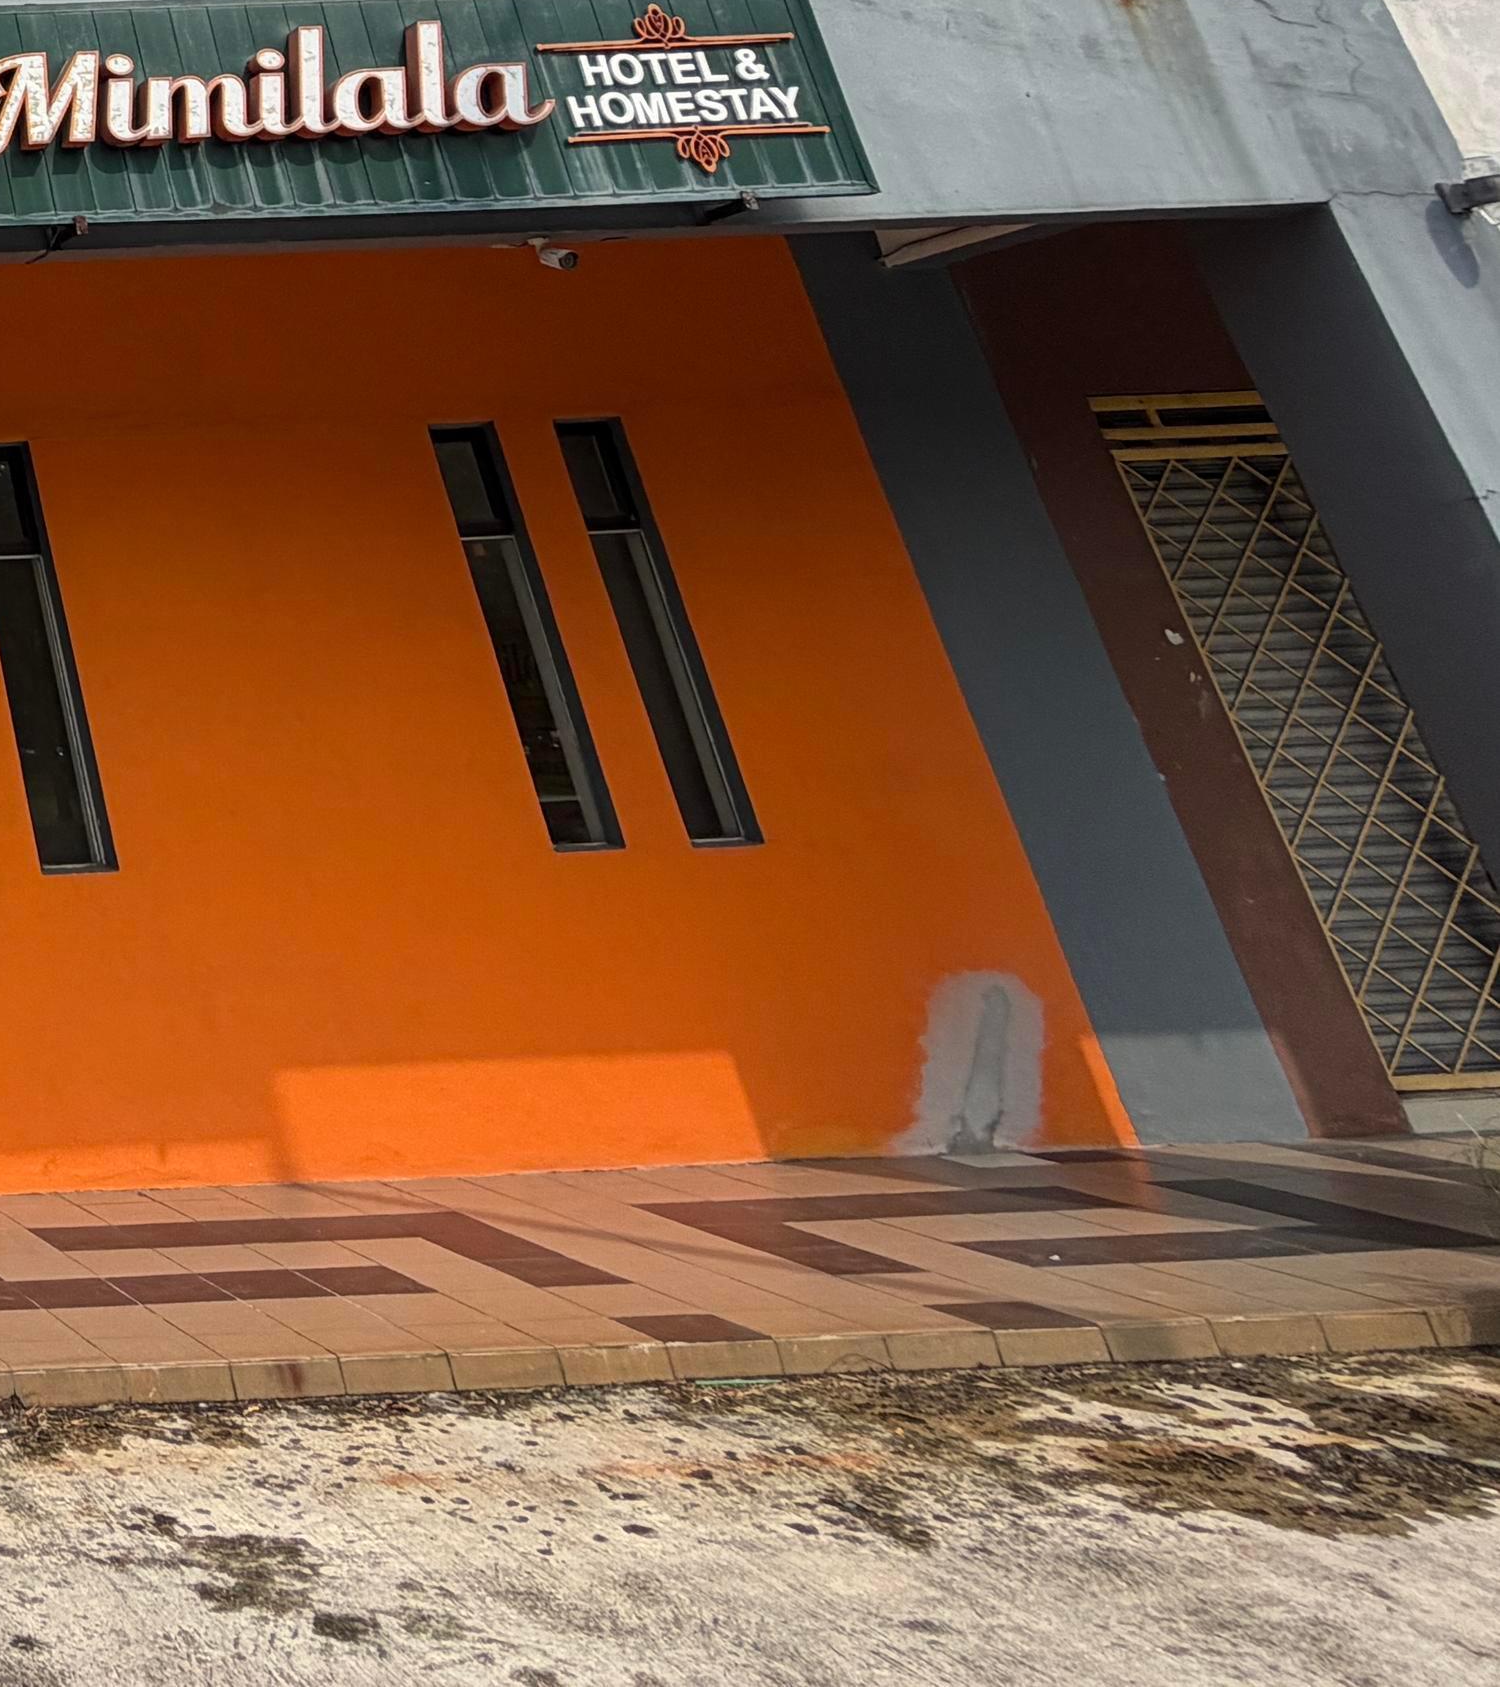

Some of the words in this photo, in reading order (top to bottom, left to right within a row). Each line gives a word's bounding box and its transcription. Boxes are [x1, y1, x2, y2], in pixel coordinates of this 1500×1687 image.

[576, 50, 730, 88] HOTEL
[734, 47, 772, 83] &
[565, 85, 802, 129] HOMESTAY
